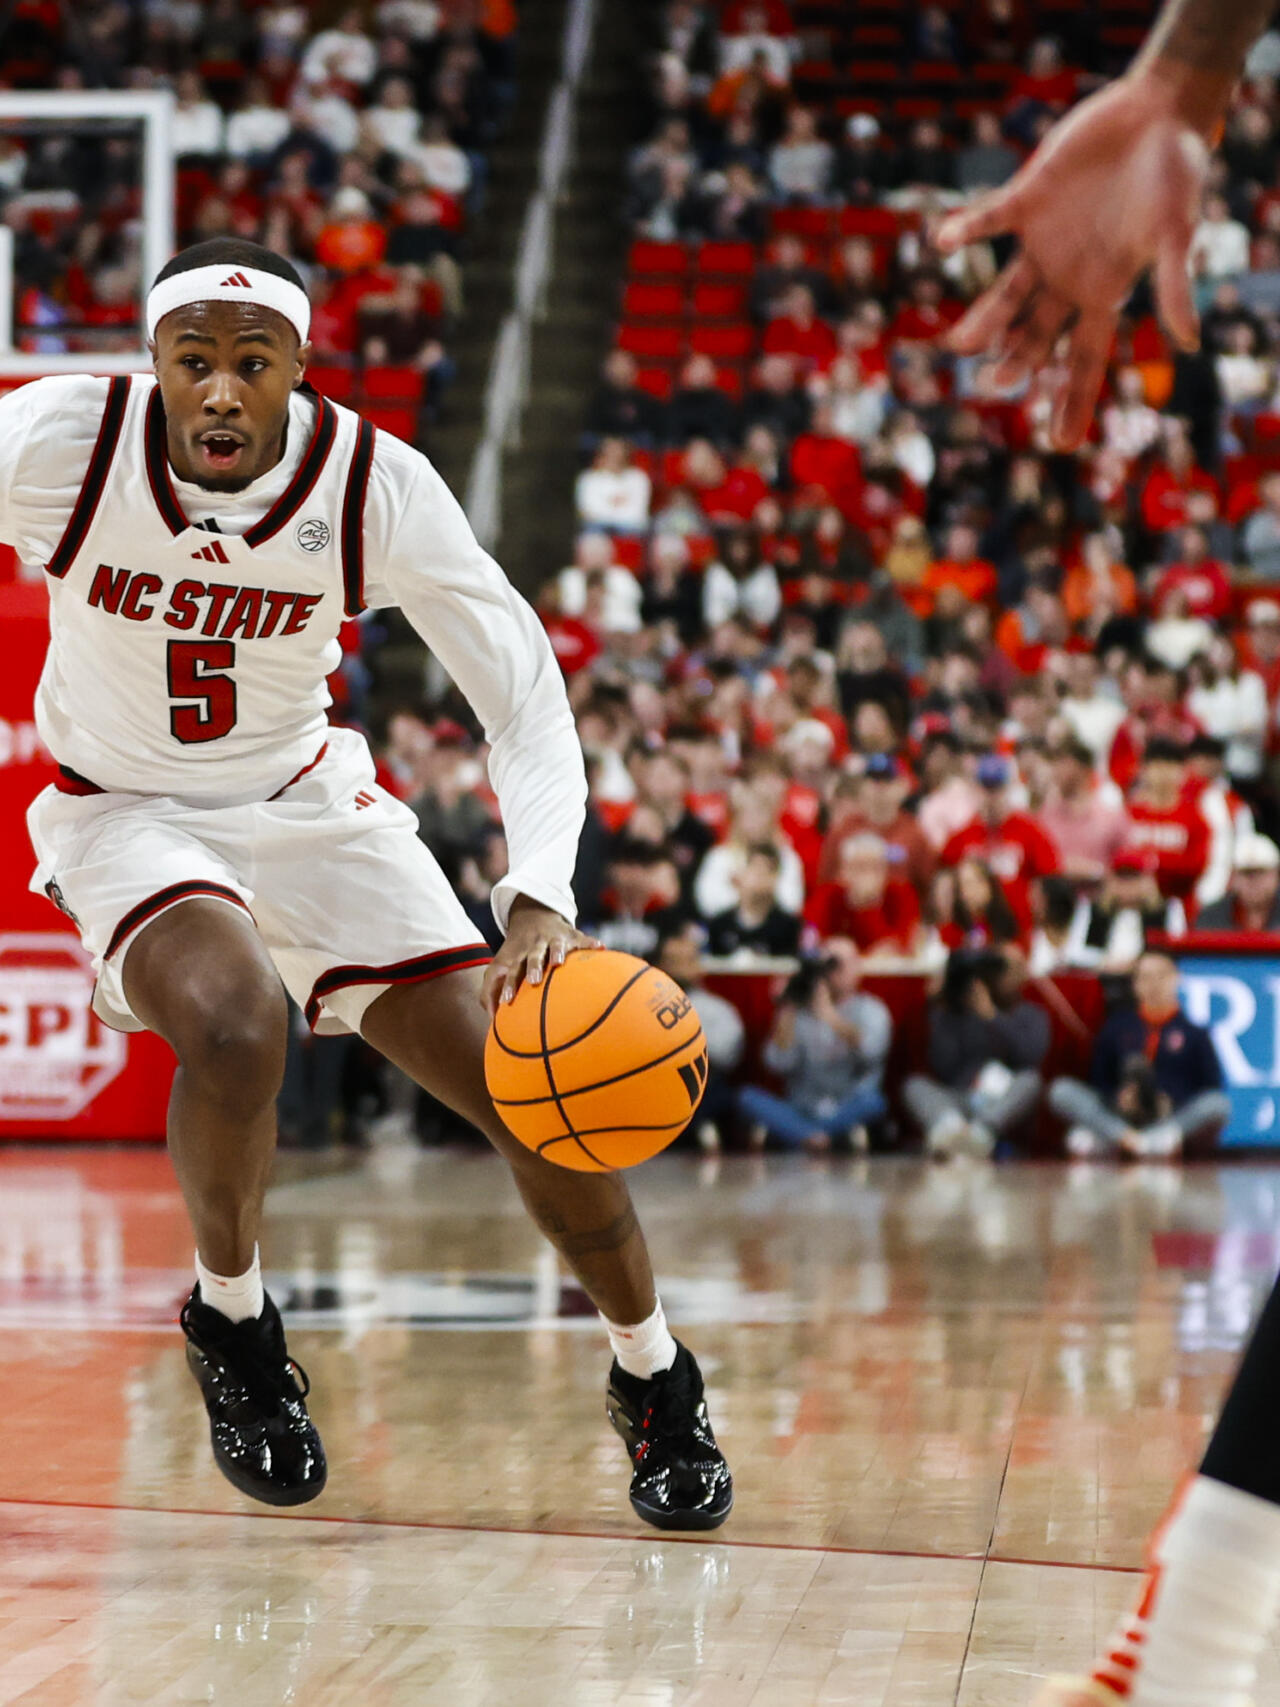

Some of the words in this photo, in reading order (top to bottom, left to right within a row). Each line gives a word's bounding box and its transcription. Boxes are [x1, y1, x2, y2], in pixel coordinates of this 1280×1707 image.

[302, 528, 328, 539] ACC
[87, 564, 164, 622] NC
[163, 578, 325, 639] STATE
[166, 639, 238, 745] 5
